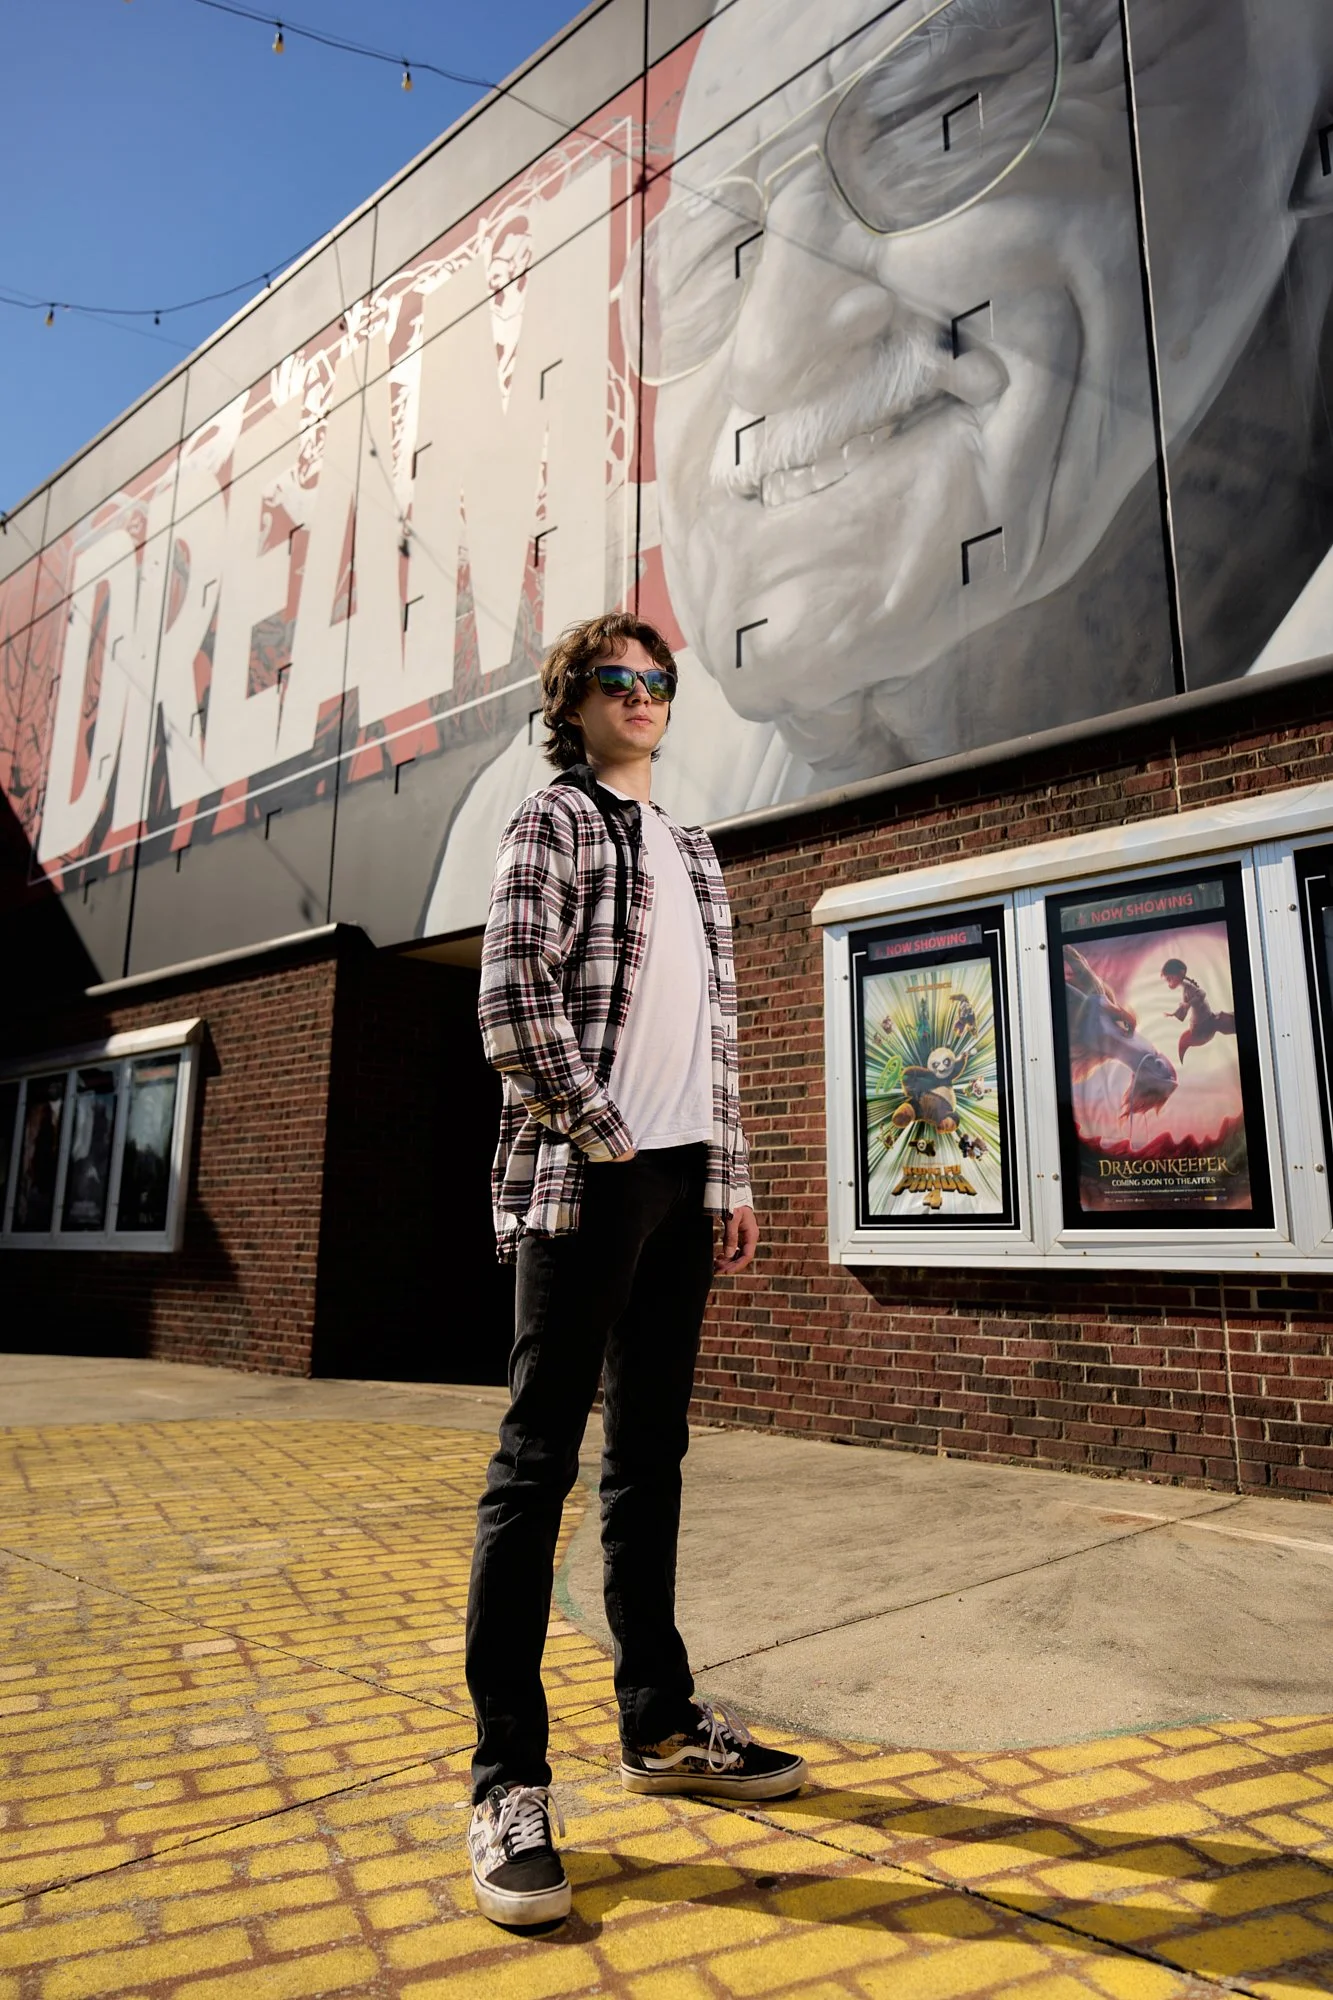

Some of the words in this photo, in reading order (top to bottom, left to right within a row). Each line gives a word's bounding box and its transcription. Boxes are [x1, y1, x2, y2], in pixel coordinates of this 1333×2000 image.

[37, 155, 612, 864] DREAM
[1091, 907, 1123, 924] NOW
[1127, 892, 1194, 917] SHOWING
[886, 941, 912, 956] NOW
[914, 931, 967, 952] SHOWING
[903, 1165, 941, 1176] KUNG
[944, 1164, 961, 1175] FU
[1099, 1156, 1239, 1178] DRAGONKEEPER
[891, 1175, 977, 1196] PANDA
[1111, 1178, 1140, 1187] COMING
[1141, 1178, 1162, 1186] SOON
[1163, 1178, 1175, 1186] TO
[1176, 1176, 1216, 1185] THEATERS
[922, 1188, 943, 1210] 4
